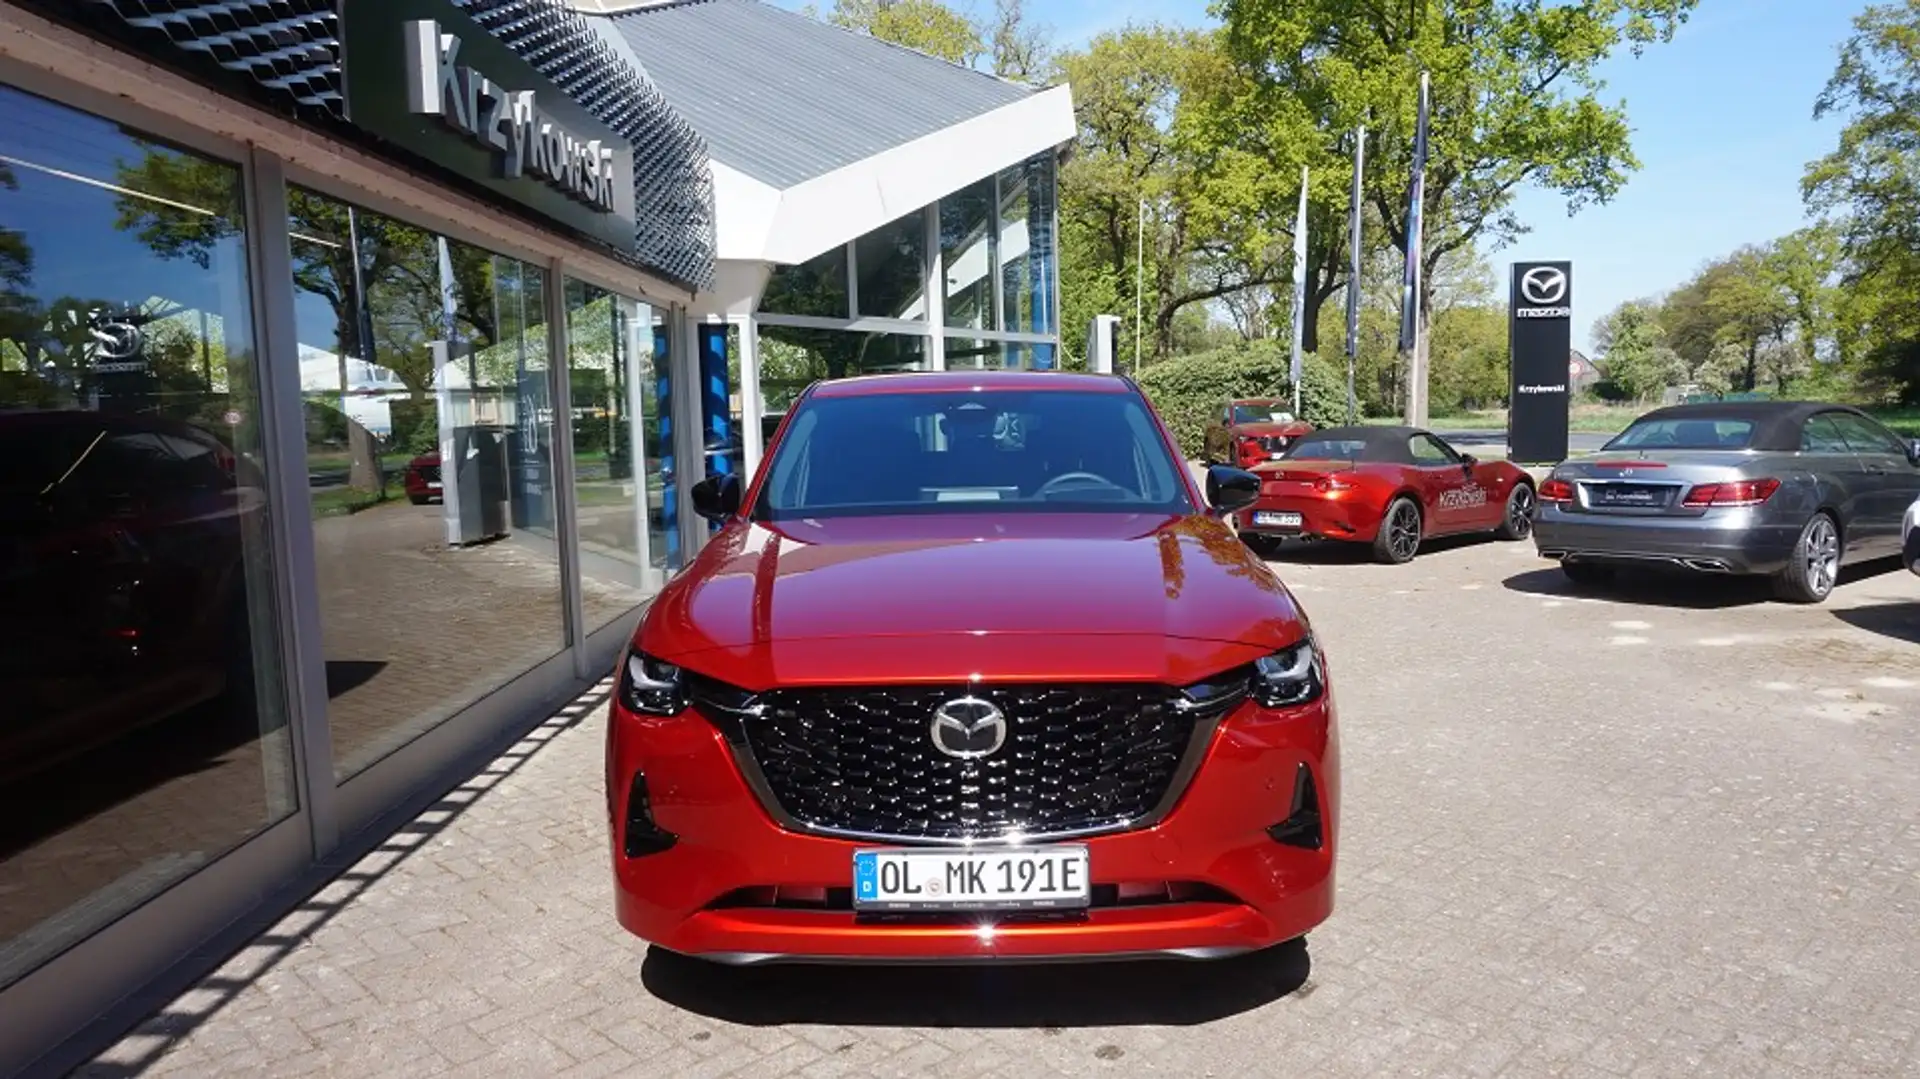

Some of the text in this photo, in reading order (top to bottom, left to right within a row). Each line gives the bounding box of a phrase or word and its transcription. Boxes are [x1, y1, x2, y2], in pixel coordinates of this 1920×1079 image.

[404, 18, 615, 212] Krzykowski
[1517, 306, 1571, 317] mazda
[1518, 384, 1565, 394] Krzykowski
[881, 857, 1081, 894] OL MK 191E
[863, 881, 872, 892] D
